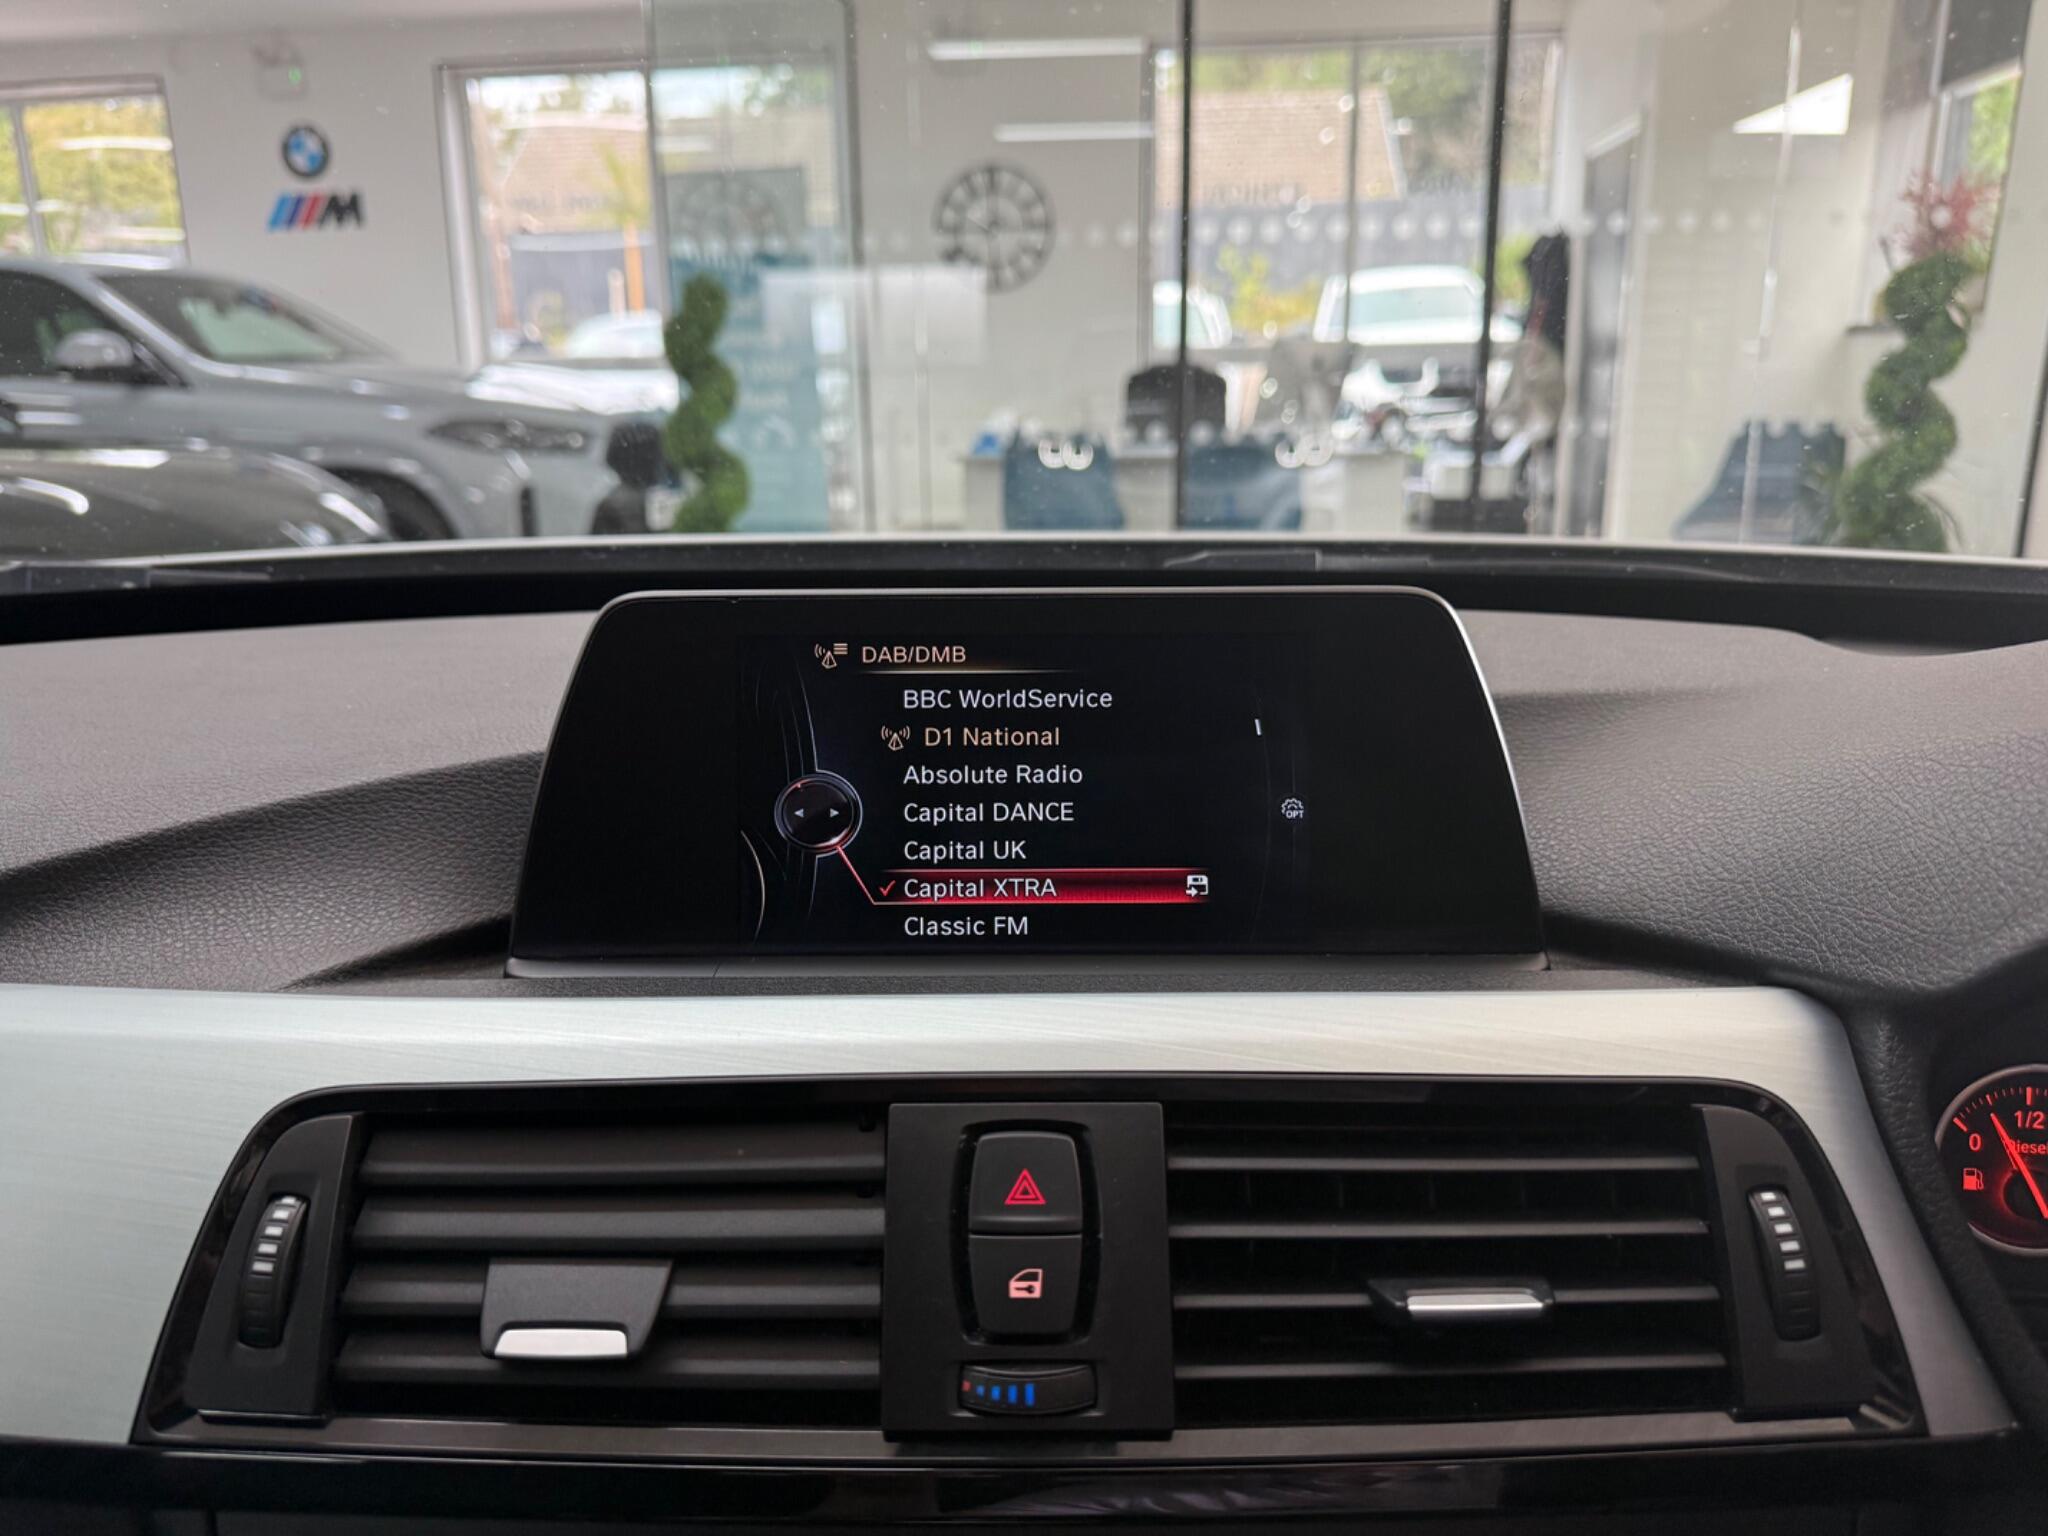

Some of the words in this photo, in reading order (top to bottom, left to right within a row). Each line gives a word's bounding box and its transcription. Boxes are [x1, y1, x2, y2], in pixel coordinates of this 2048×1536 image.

[861, 645, 967, 664] DAB/DMB
[903, 689, 952, 709] BBC
[958, 688, 1113, 709] WorldService
[925, 727, 952, 747] D1
[963, 727, 1060, 746] National
[903, 764, 1008, 785] Absolute
[1016, 764, 1083, 784] Radio
[904, 802, 984, 827] Capital
[993, 802, 1075, 822] DANCE
[1286, 810, 1304, 819] OPT
[904, 840, 984, 864] Capital
[993, 840, 1027, 860] UK
[904, 878, 984, 902] Capital
[993, 878, 1057, 897] XTRA
[904, 916, 985, 936] Classic
[994, 916, 1028, 936] FM
[2014, 1110, 2045, 1129] 1/2
[1968, 1133, 1982, 1151] 0
